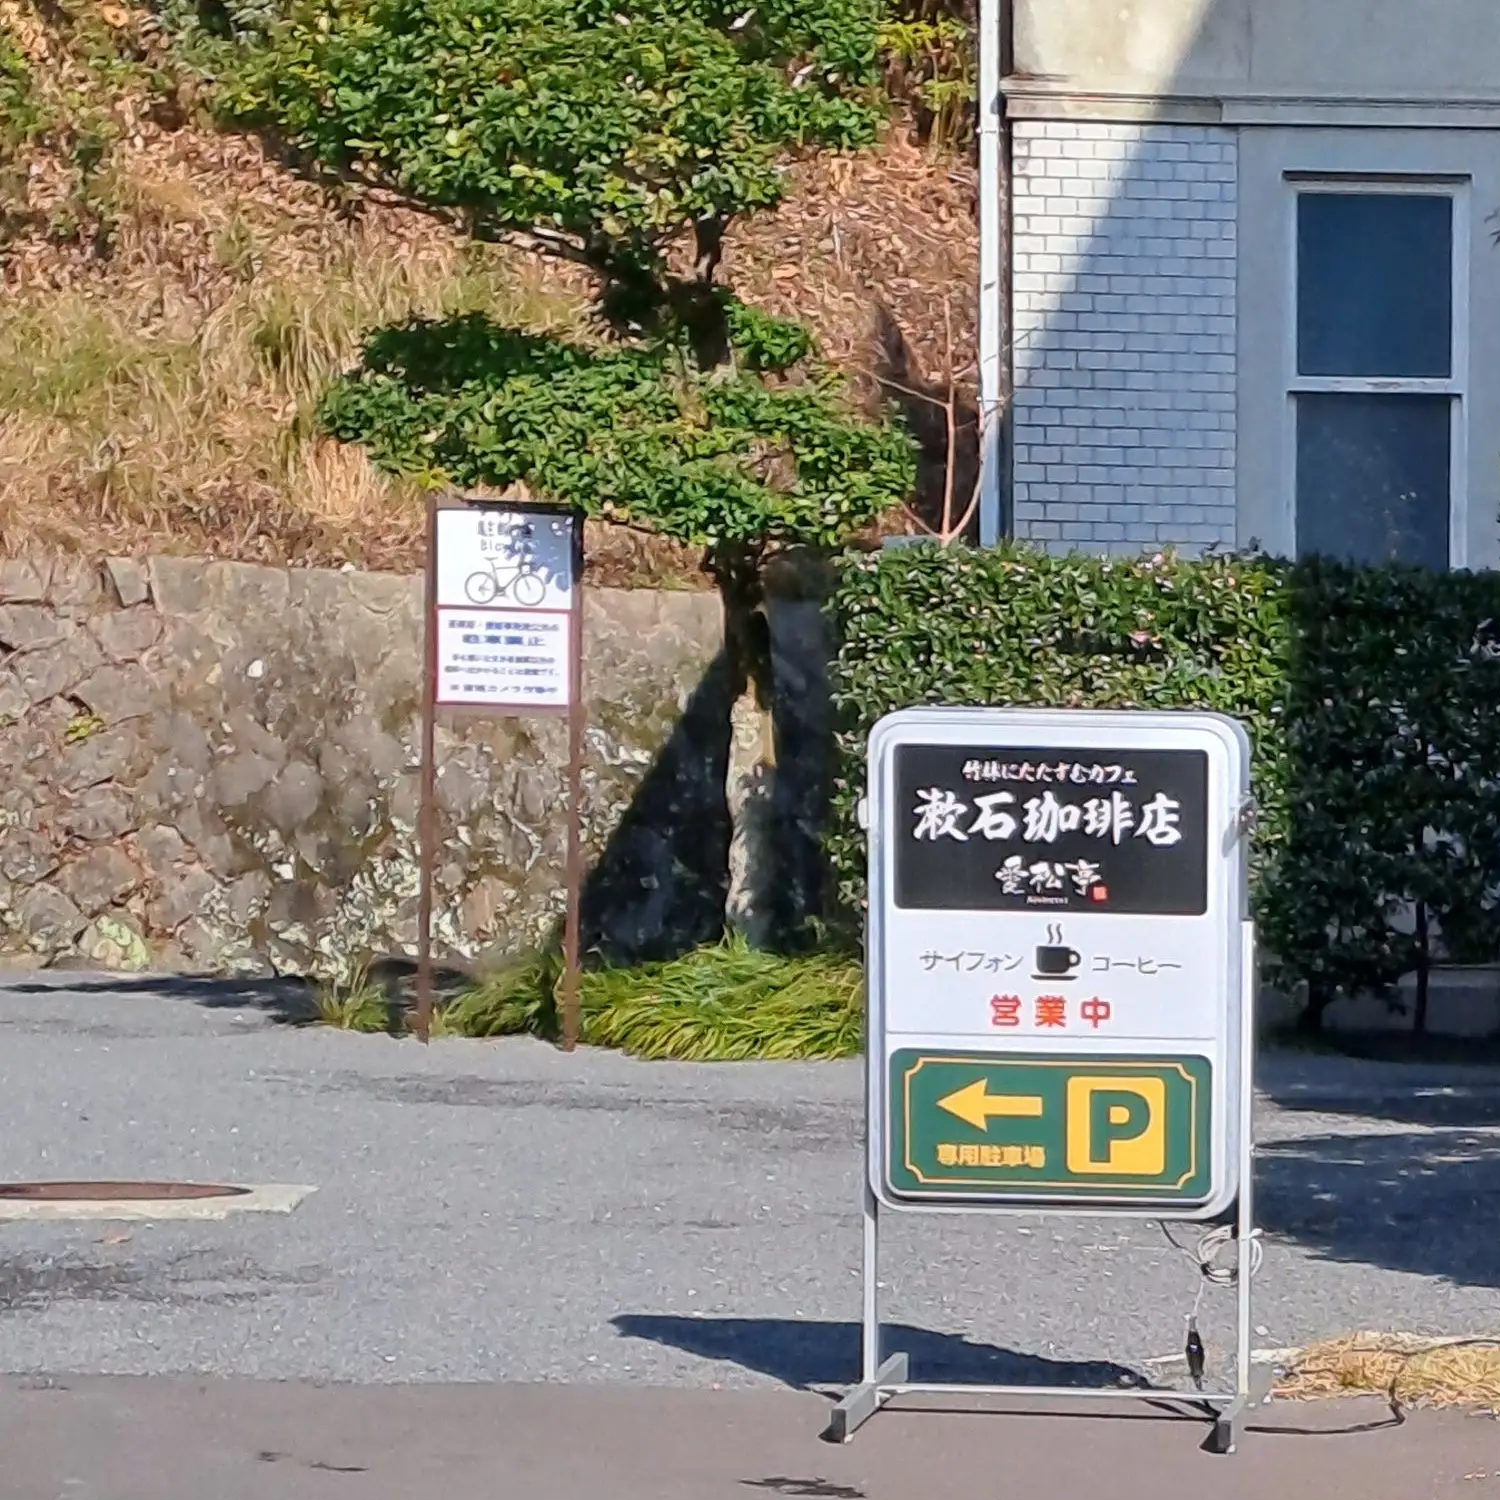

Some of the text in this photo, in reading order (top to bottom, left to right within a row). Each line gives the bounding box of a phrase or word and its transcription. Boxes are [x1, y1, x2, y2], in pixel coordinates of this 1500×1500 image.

[912, 788, 1184, 846] 漱石珈琲店
[918, 949, 1025, 973] サイフォン
[1091, 955, 1183, 975] コーヒー
[990, 995, 1112, 1029] 営業中
[1089, 1087, 1152, 1164] P
